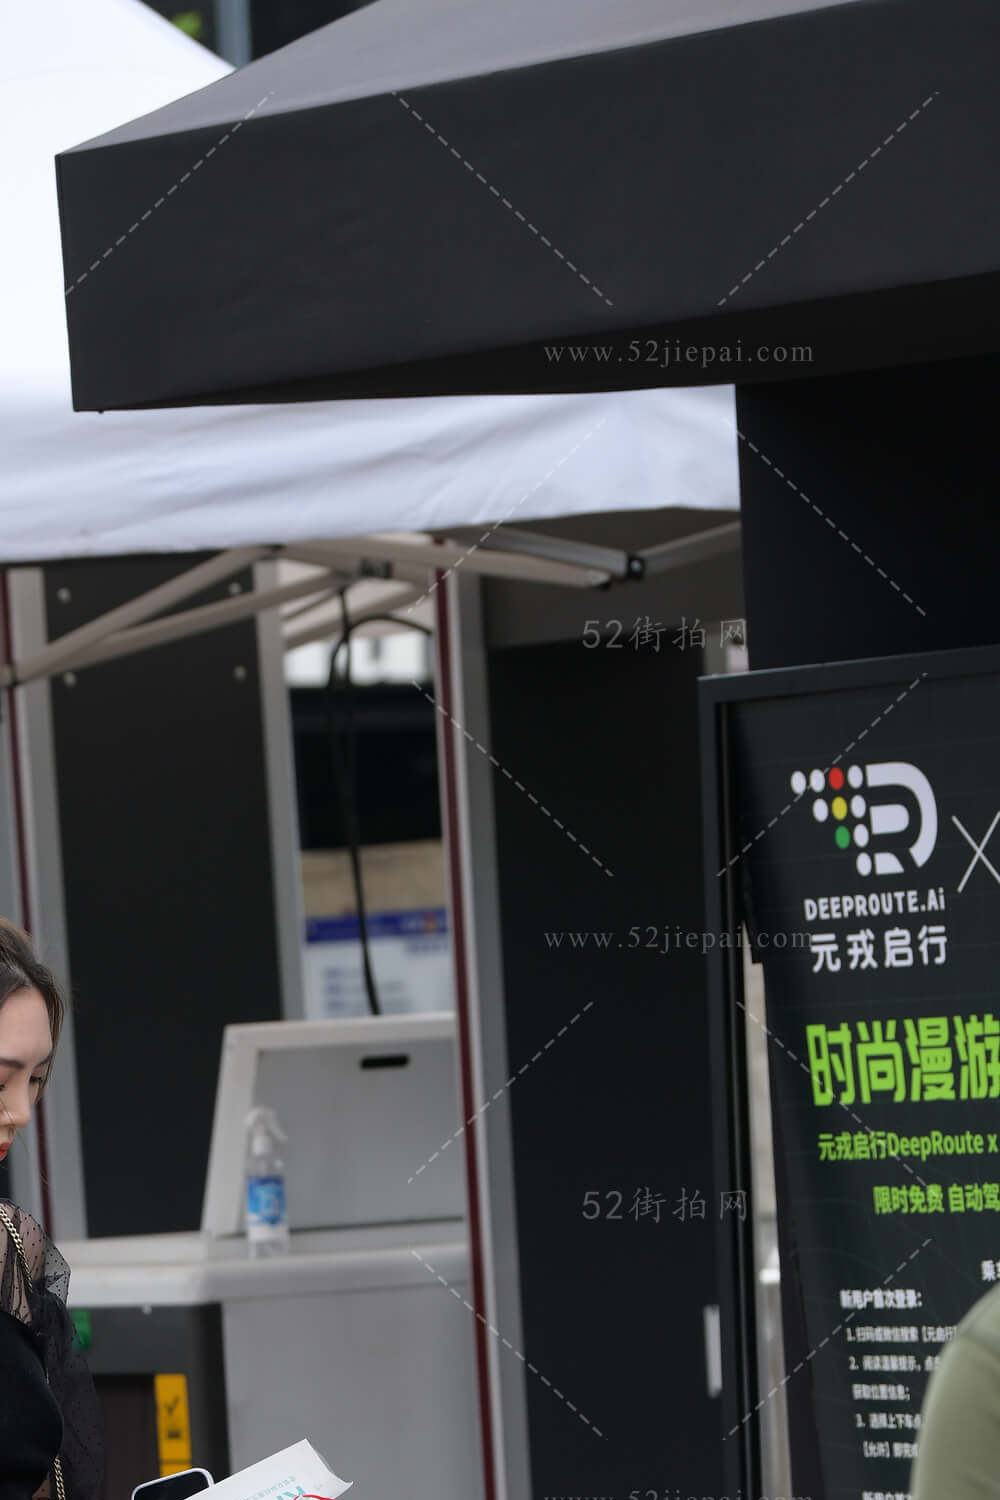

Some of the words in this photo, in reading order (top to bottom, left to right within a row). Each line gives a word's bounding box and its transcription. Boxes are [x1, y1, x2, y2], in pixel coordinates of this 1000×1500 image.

[804, 888, 945, 921] DEEPROUTE.Ai
[811, 926, 947, 973] 元戎启行
[806, 1014, 1000, 1106] 时尚漫游
[818, 1130, 984, 1162] 元戎启行DeepRoute
[873, 1183, 945, 1214] 限时免费
